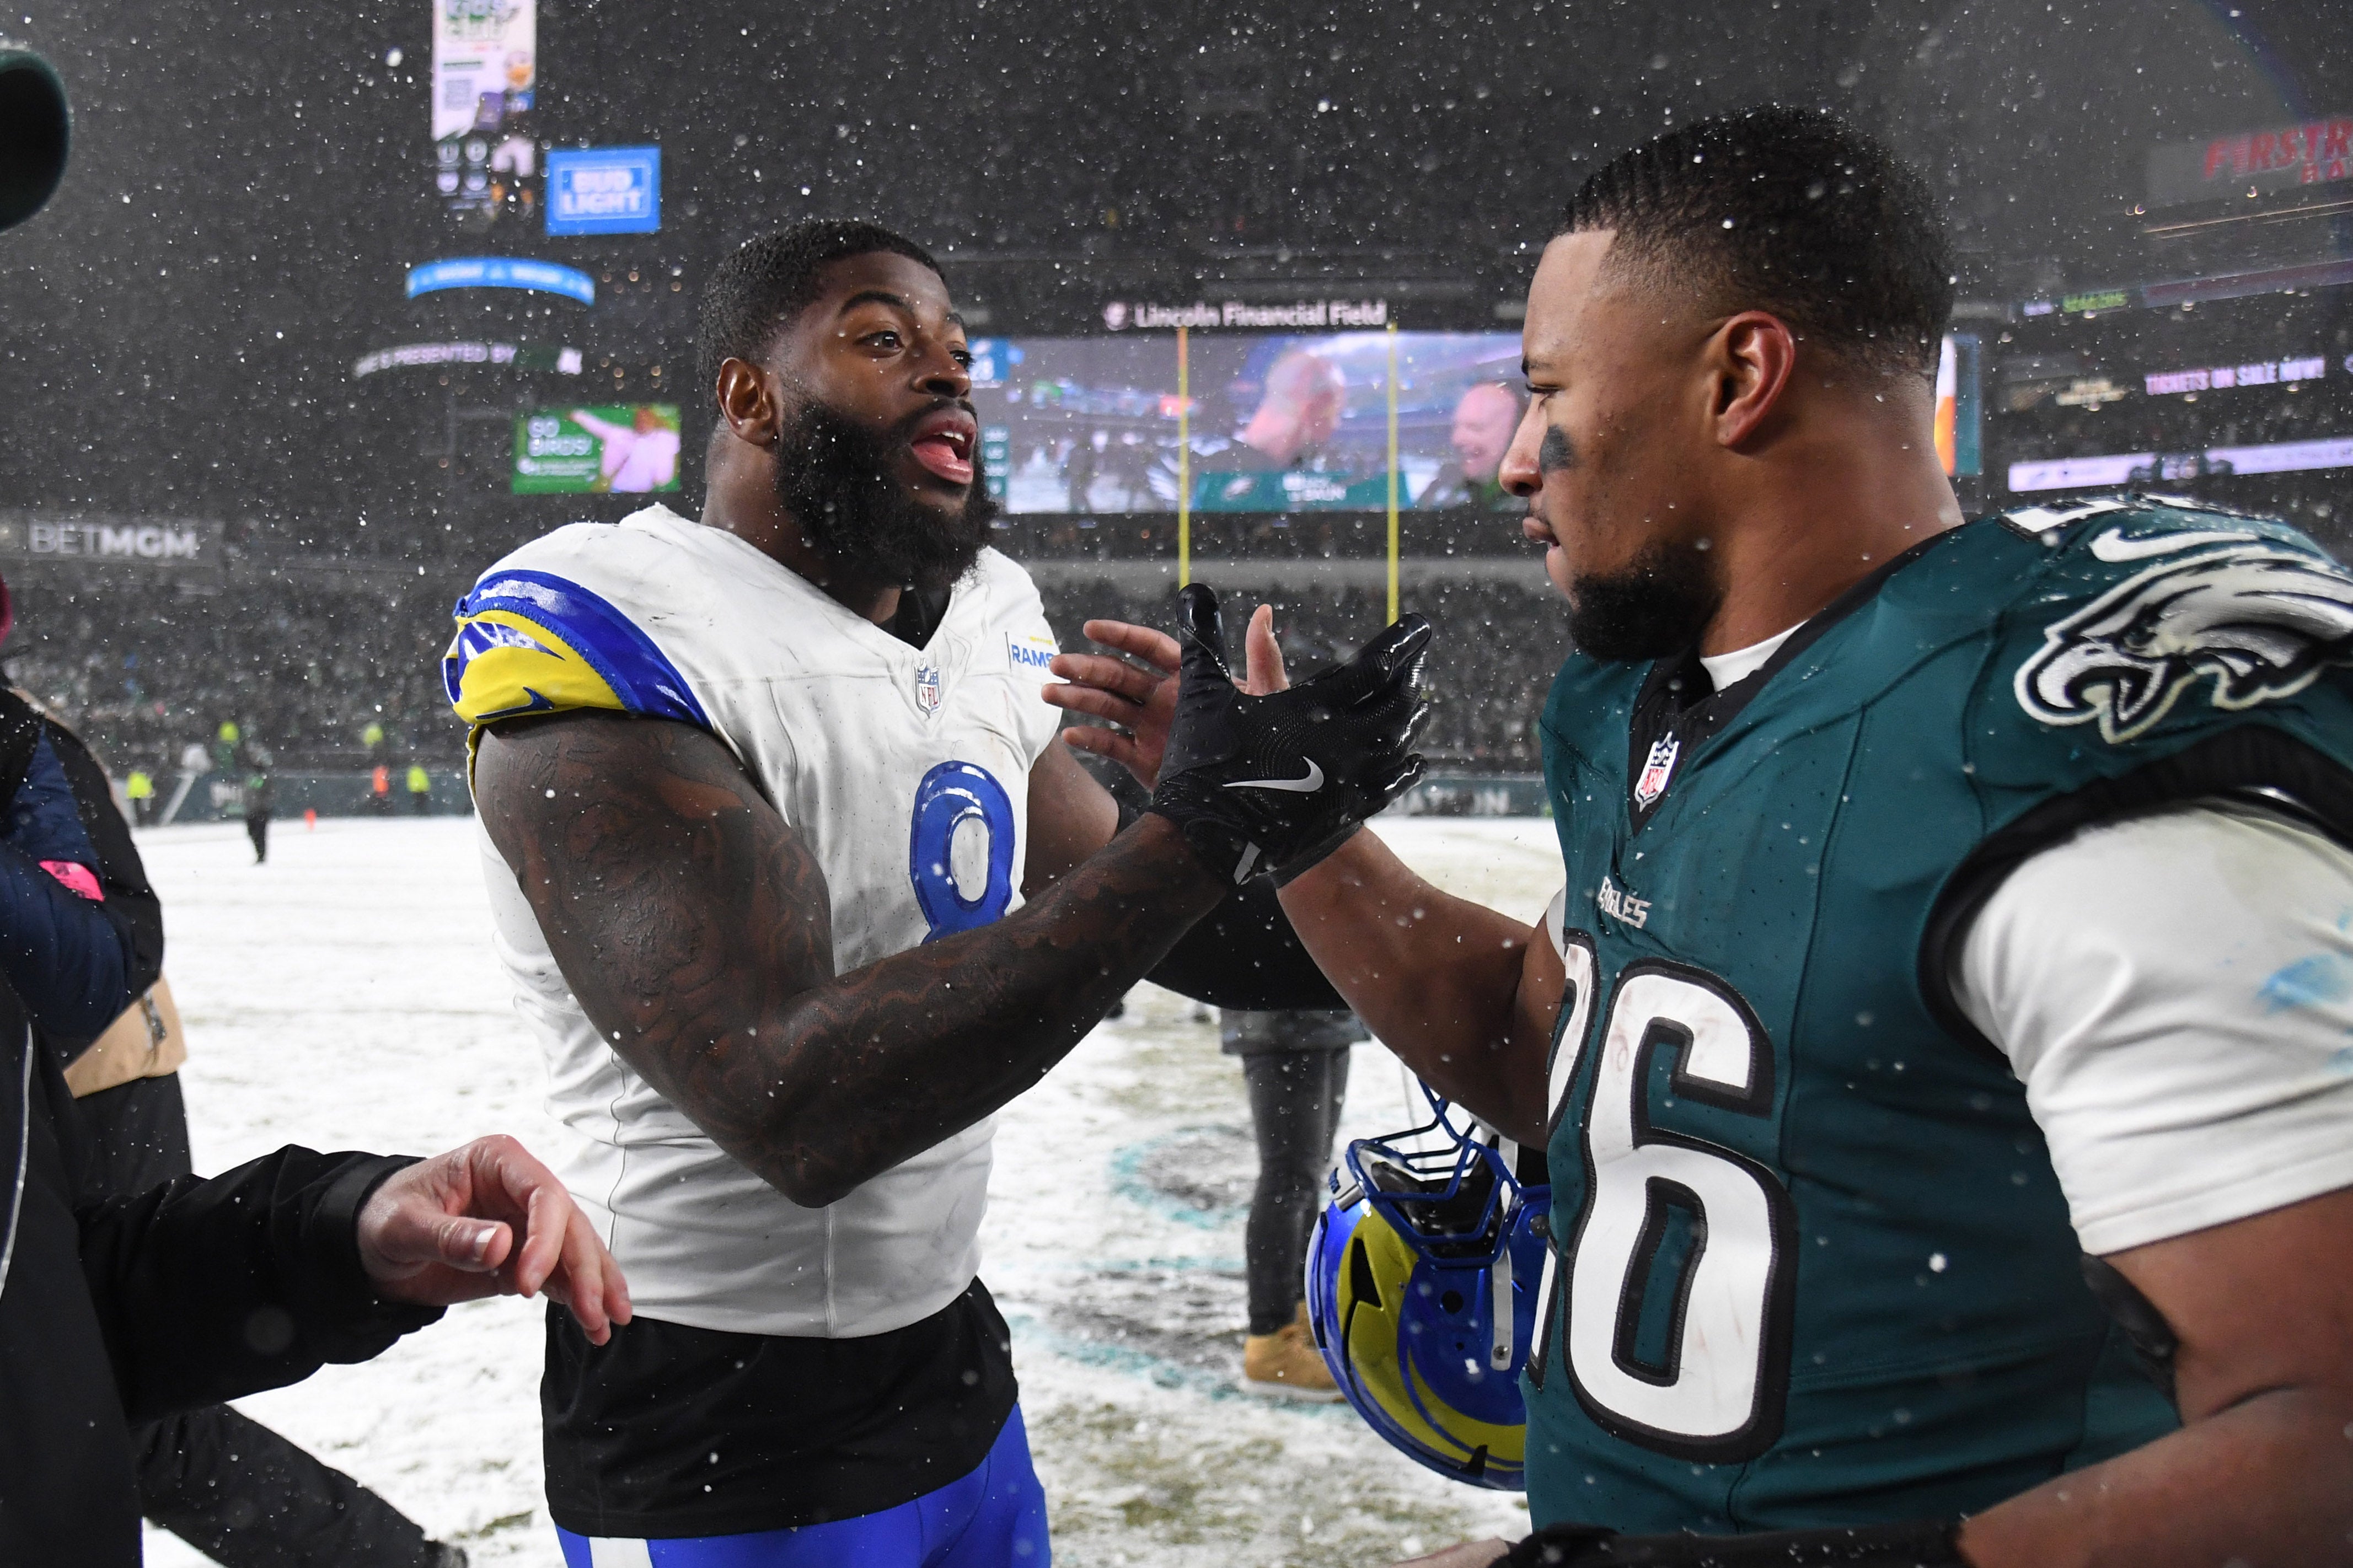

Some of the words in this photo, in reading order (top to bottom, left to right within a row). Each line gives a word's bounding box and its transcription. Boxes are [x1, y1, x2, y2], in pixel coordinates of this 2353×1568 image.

[561, 188, 641, 214] LIGHT
[1134, 301, 1220, 327] Lincoln
[1222, 300, 1327, 327] Financial
[1328, 298, 1388, 326] Field
[2236, 362, 2279, 386] SALE
[28, 520, 198, 560] BETMGM
